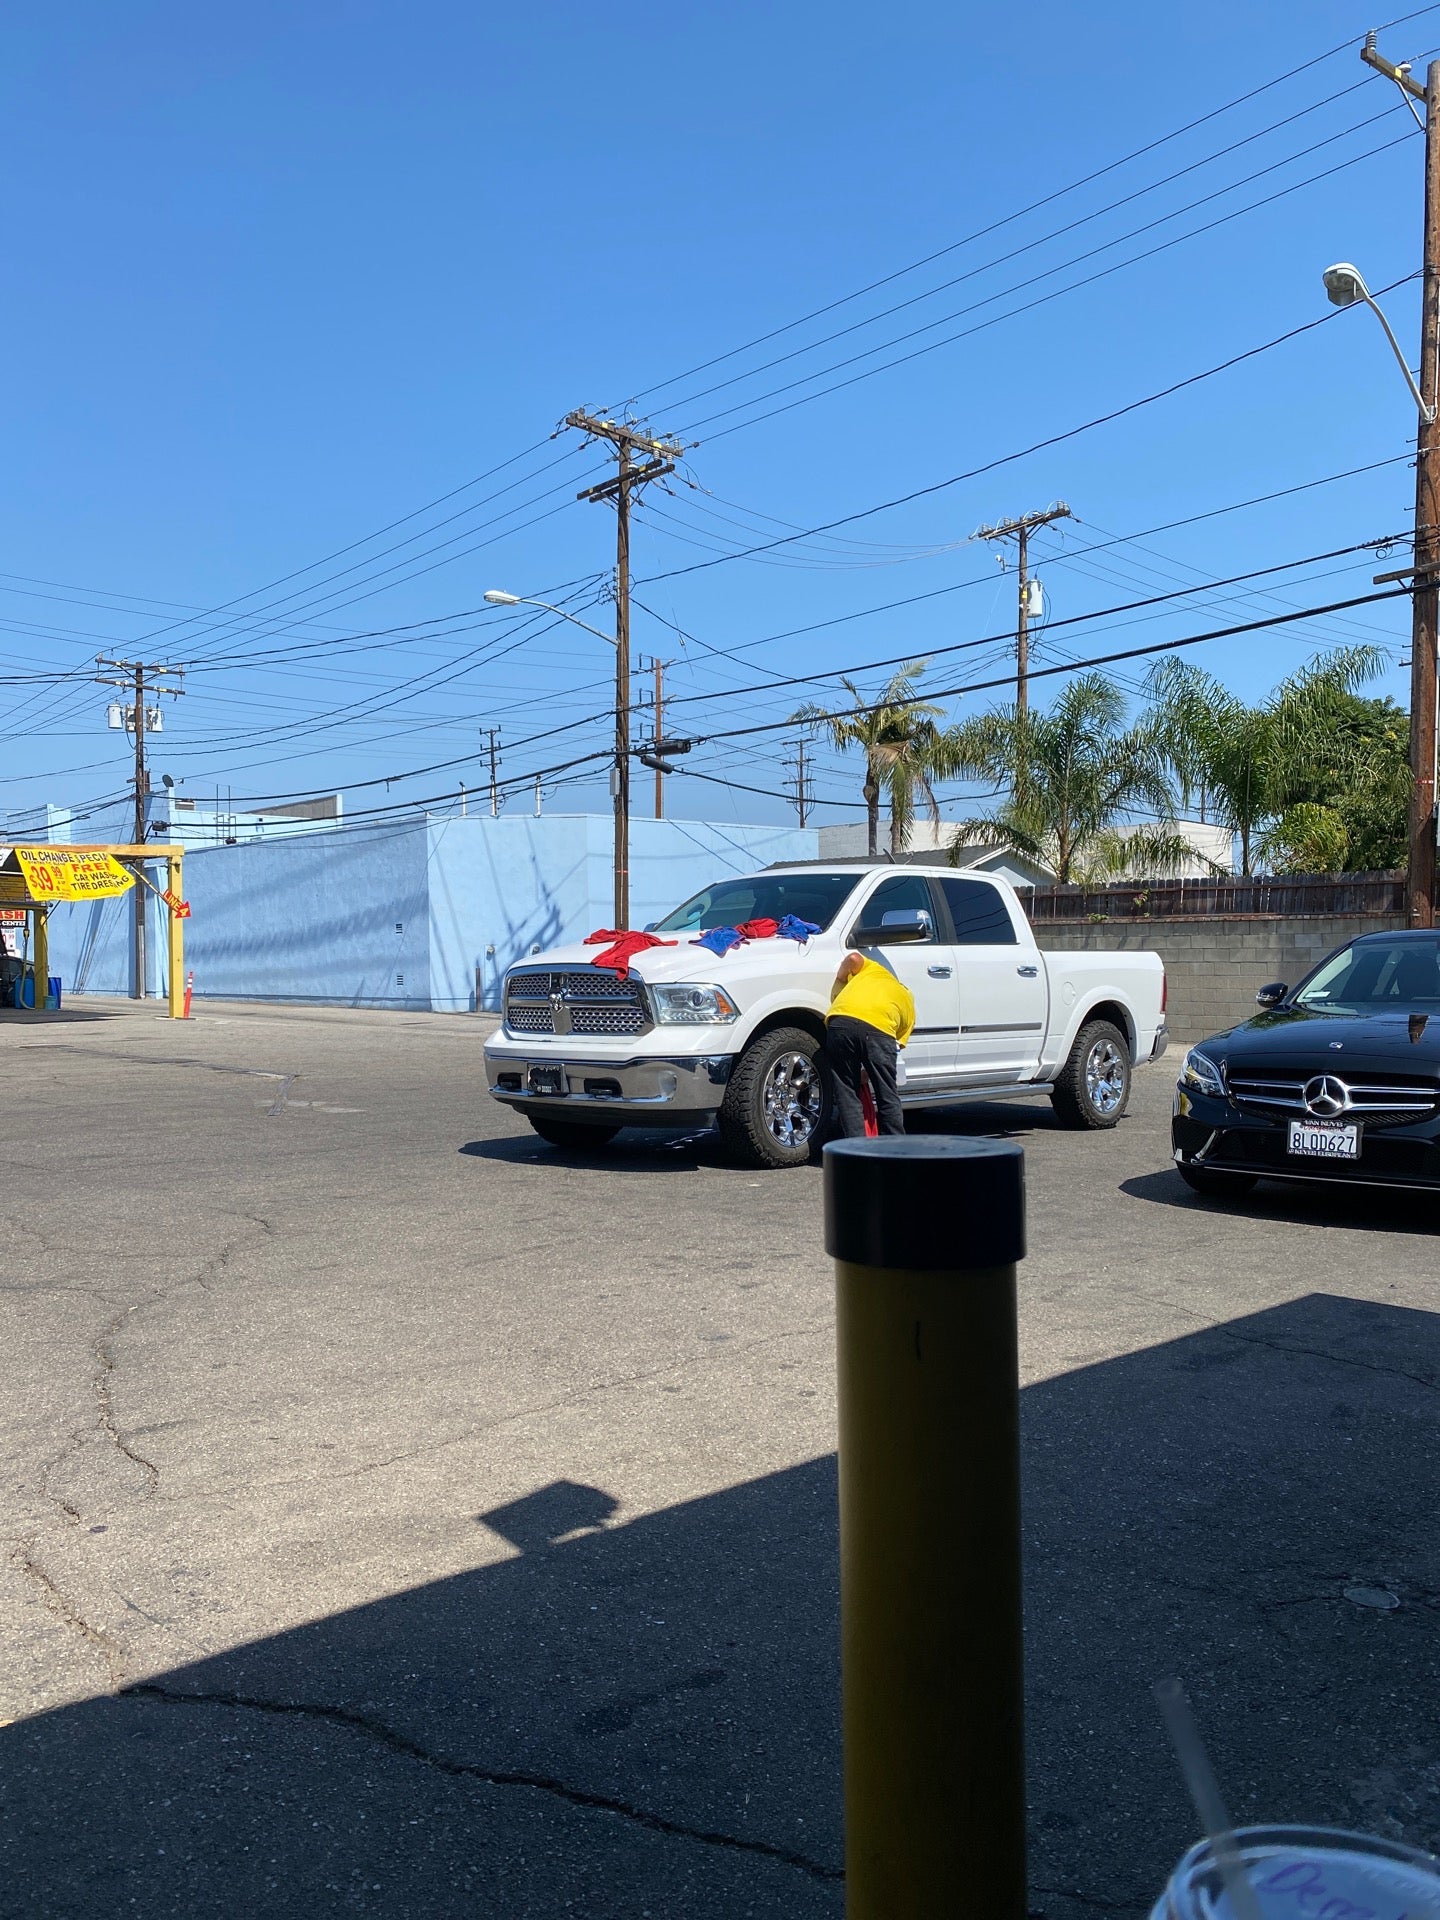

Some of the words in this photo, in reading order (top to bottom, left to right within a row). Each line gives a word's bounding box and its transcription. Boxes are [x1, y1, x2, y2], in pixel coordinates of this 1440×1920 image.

[20, 850, 38, 861] OIL
[38, 851, 75, 862] CHANGE
[75, 853, 107, 863] PECI
[74, 873, 90, 881] CAR
[90, 872, 112, 881] WAS
[70, 881, 91, 890] TIRE
[163, 889, 182, 912] LINE
[179, 907, 189, 917] 4
